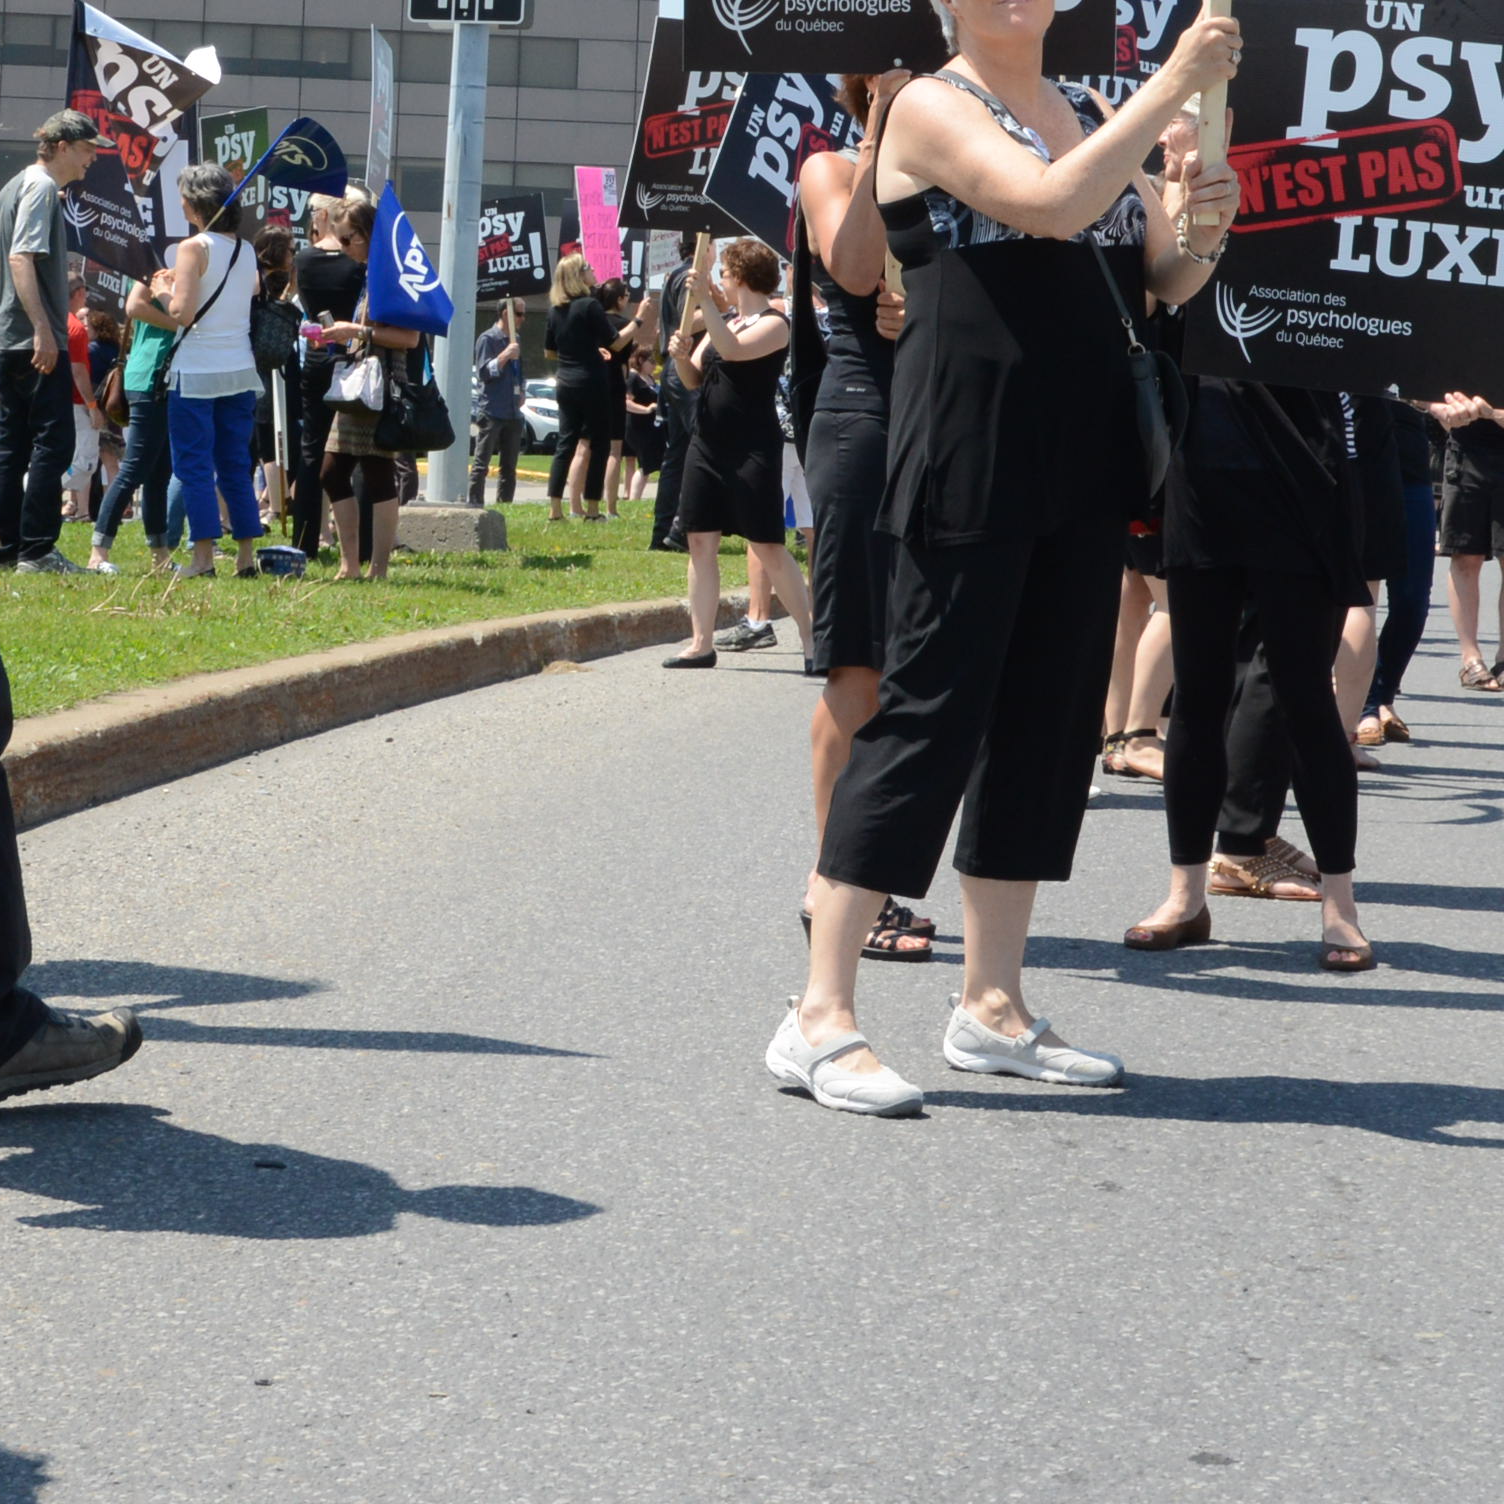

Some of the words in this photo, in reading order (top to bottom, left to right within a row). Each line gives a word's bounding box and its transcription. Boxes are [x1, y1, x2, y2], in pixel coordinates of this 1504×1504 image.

[775, 18, 792, 33] du
[794, 17, 844, 34] Québec
[1365, 0, 1424, 32] UN
[142, 54, 179, 90] UN
[651, 119, 705, 150] N'EST
[746, 104, 767, 137] UN
[830, 112, 845, 137] un
[215, 130, 256, 170] psy
[748, 72, 824, 209] psy
[1239, 154, 1349, 214] N'EST
[1358, 141, 1447, 194] PAS
[80, 190, 119, 213] Association
[268, 184, 311, 221] sy
[485, 207, 497, 216] UN
[93, 227, 103, 237] du
[104, 230, 128, 248] Québec
[479, 211, 525, 246] psy
[487, 253, 530, 273] LUXE
[97, 271, 121, 294] LUXE
[1249, 284, 1321, 305] Association
[1324, 291, 1347, 307] des
[1286, 307, 1413, 336] psychologues
[1276, 329, 1293, 345] du
[1296, 332, 1344, 350] Québec
